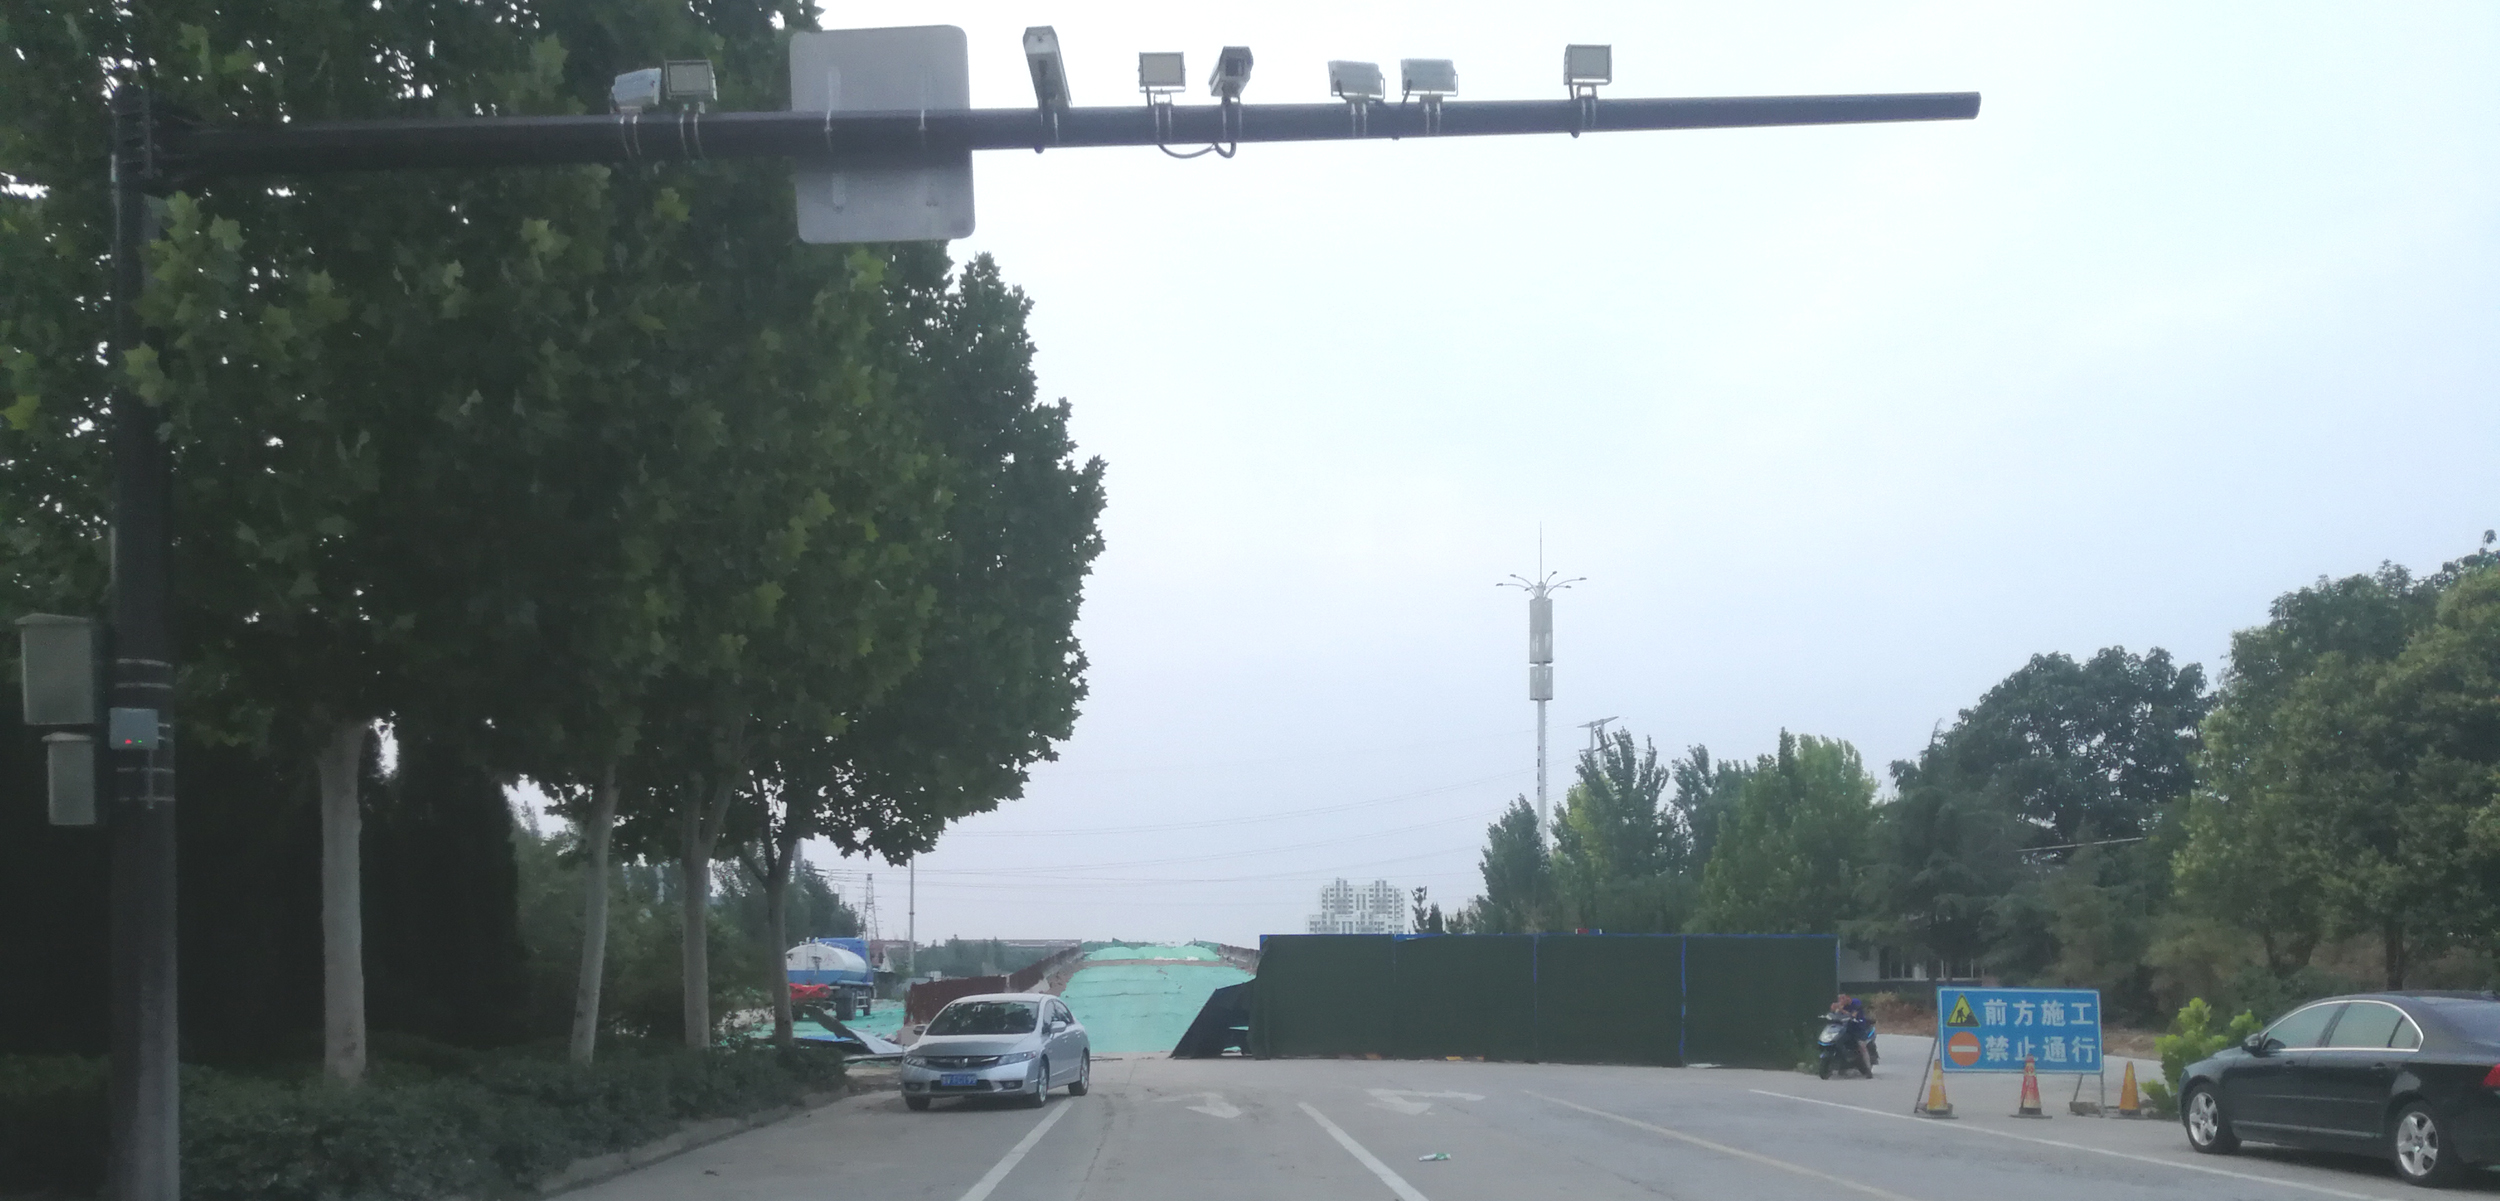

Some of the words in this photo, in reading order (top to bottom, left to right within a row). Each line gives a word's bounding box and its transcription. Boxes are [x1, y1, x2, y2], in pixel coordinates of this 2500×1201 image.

[1984, 999, 2094, 1027] 前方施工
[1986, 1036, 2095, 1063] 禁止通行
